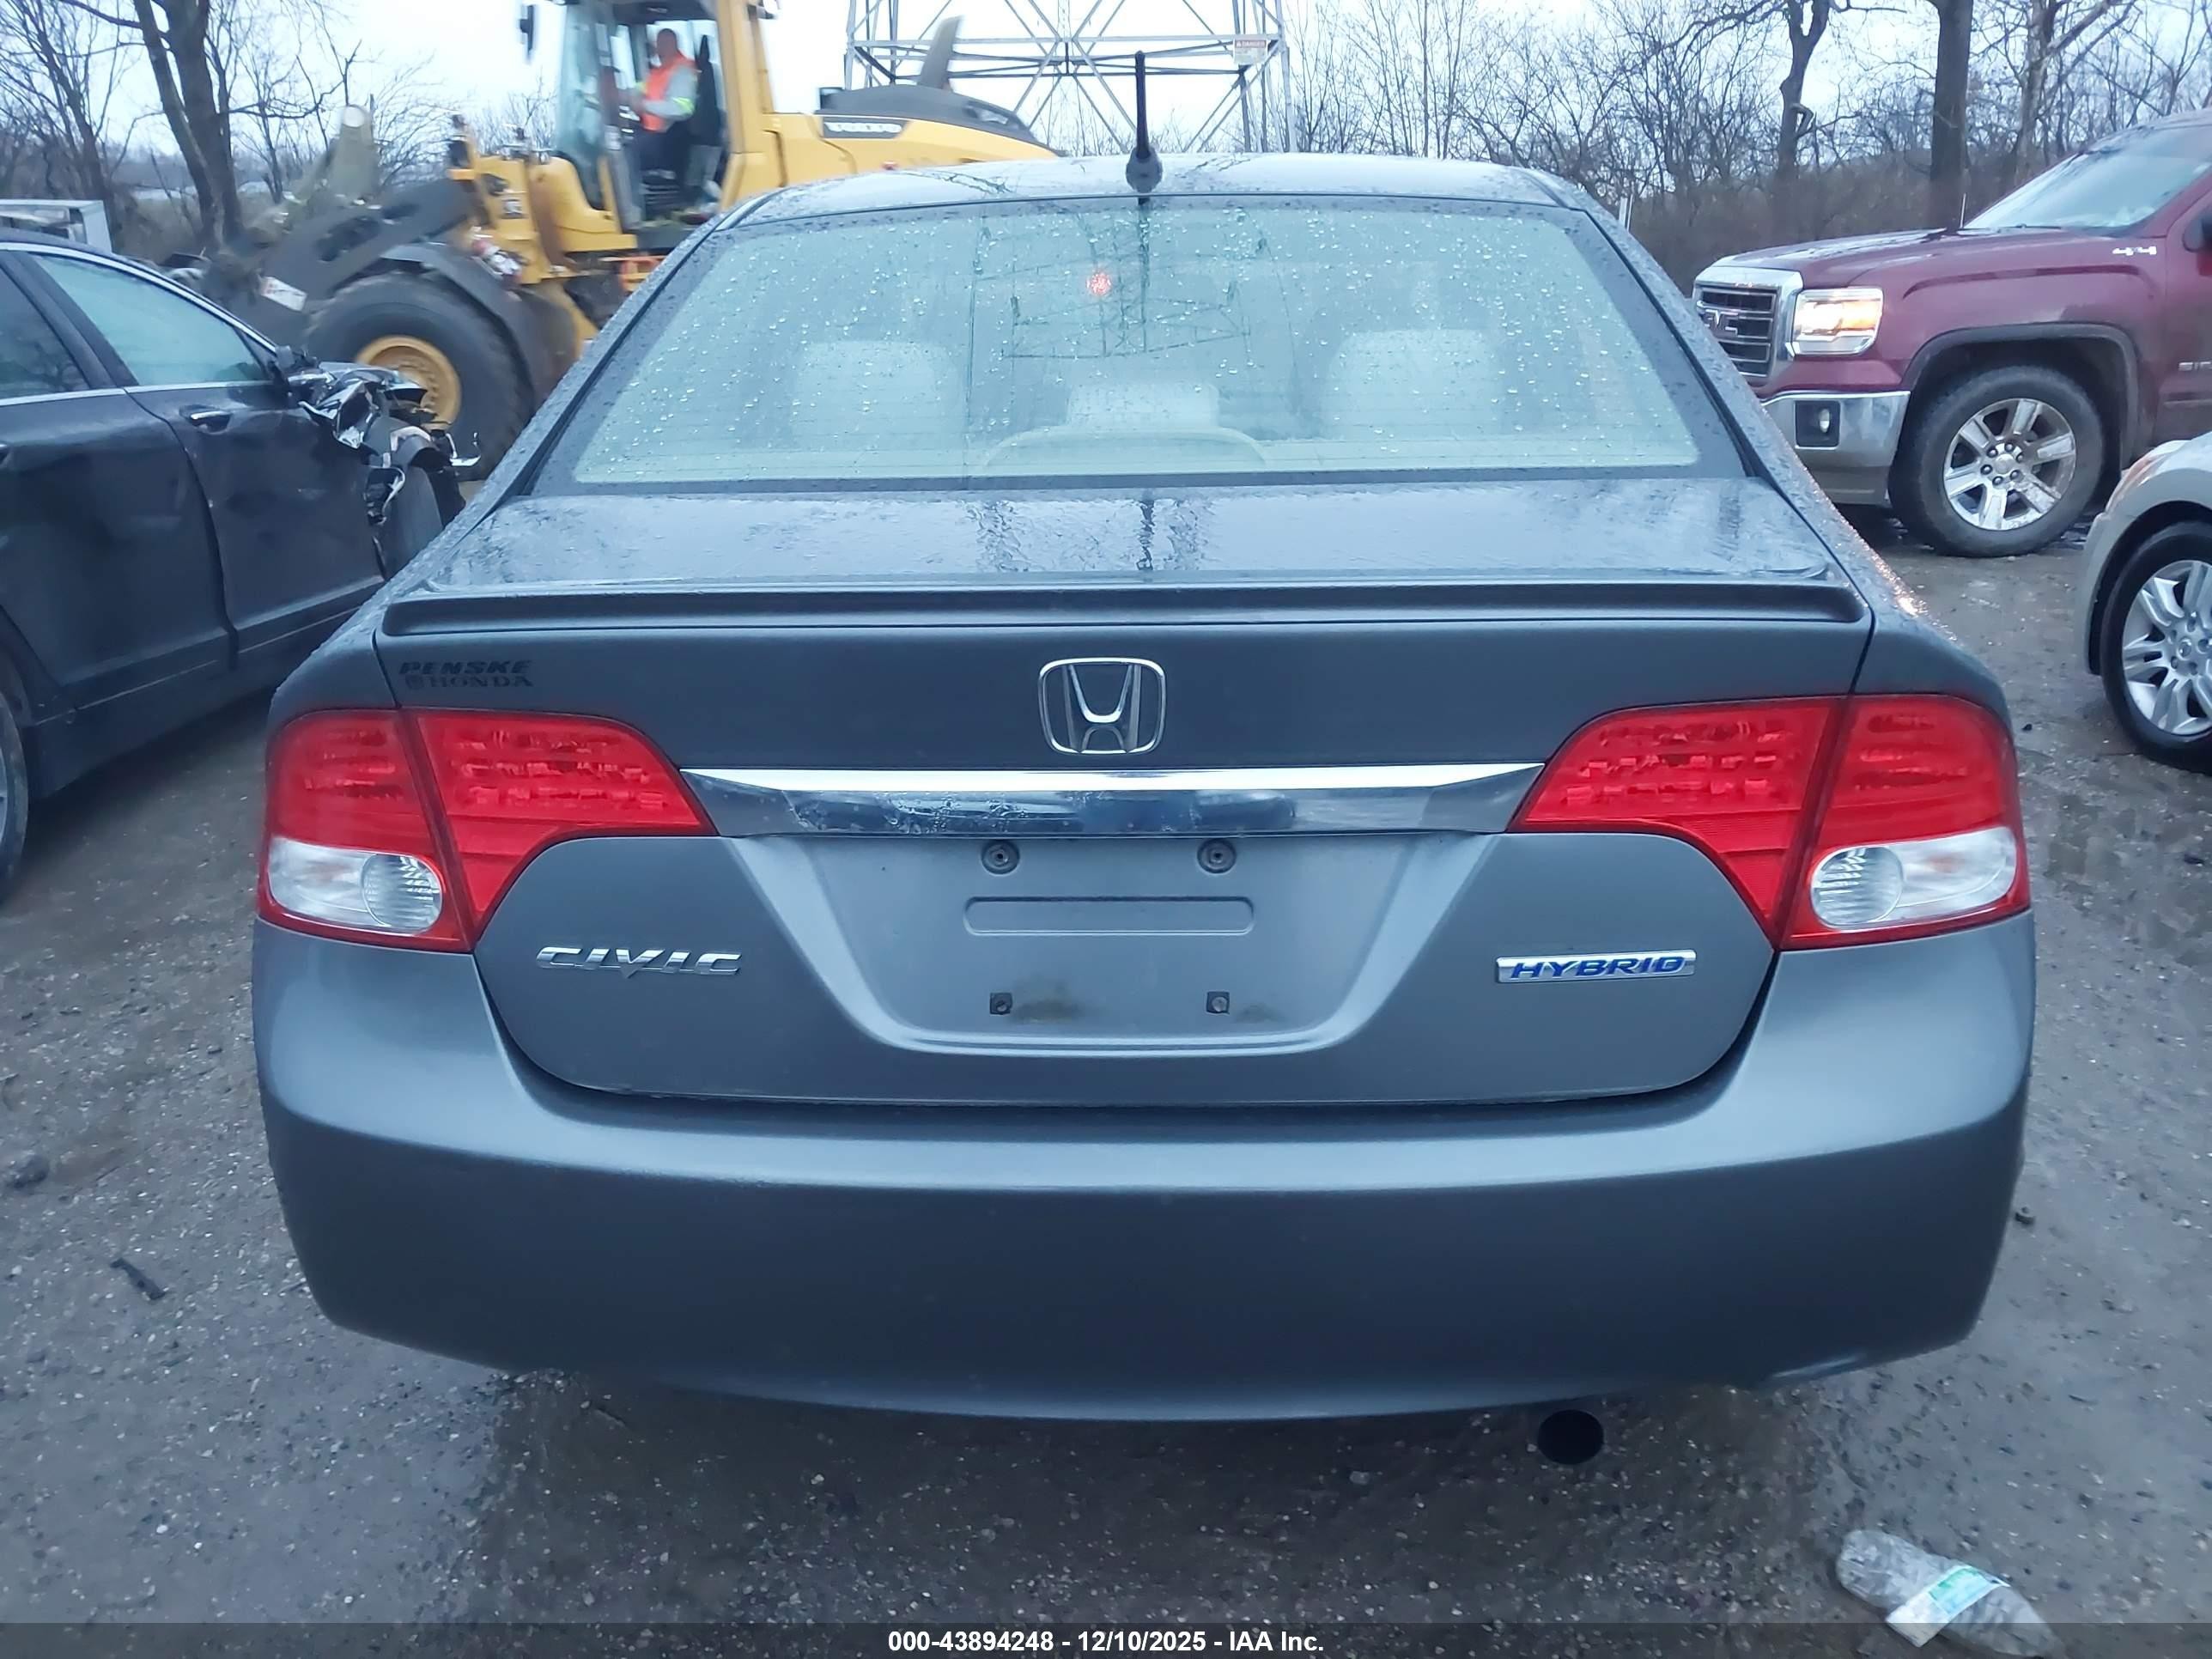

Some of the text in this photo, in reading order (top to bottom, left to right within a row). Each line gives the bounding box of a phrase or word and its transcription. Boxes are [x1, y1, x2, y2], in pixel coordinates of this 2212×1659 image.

[398, 659, 533, 675] PENSKE
[429, 675, 534, 688] HONDA
[536, 946, 743, 979] CIVIC
[1510, 956, 1686, 979] HYBRID
